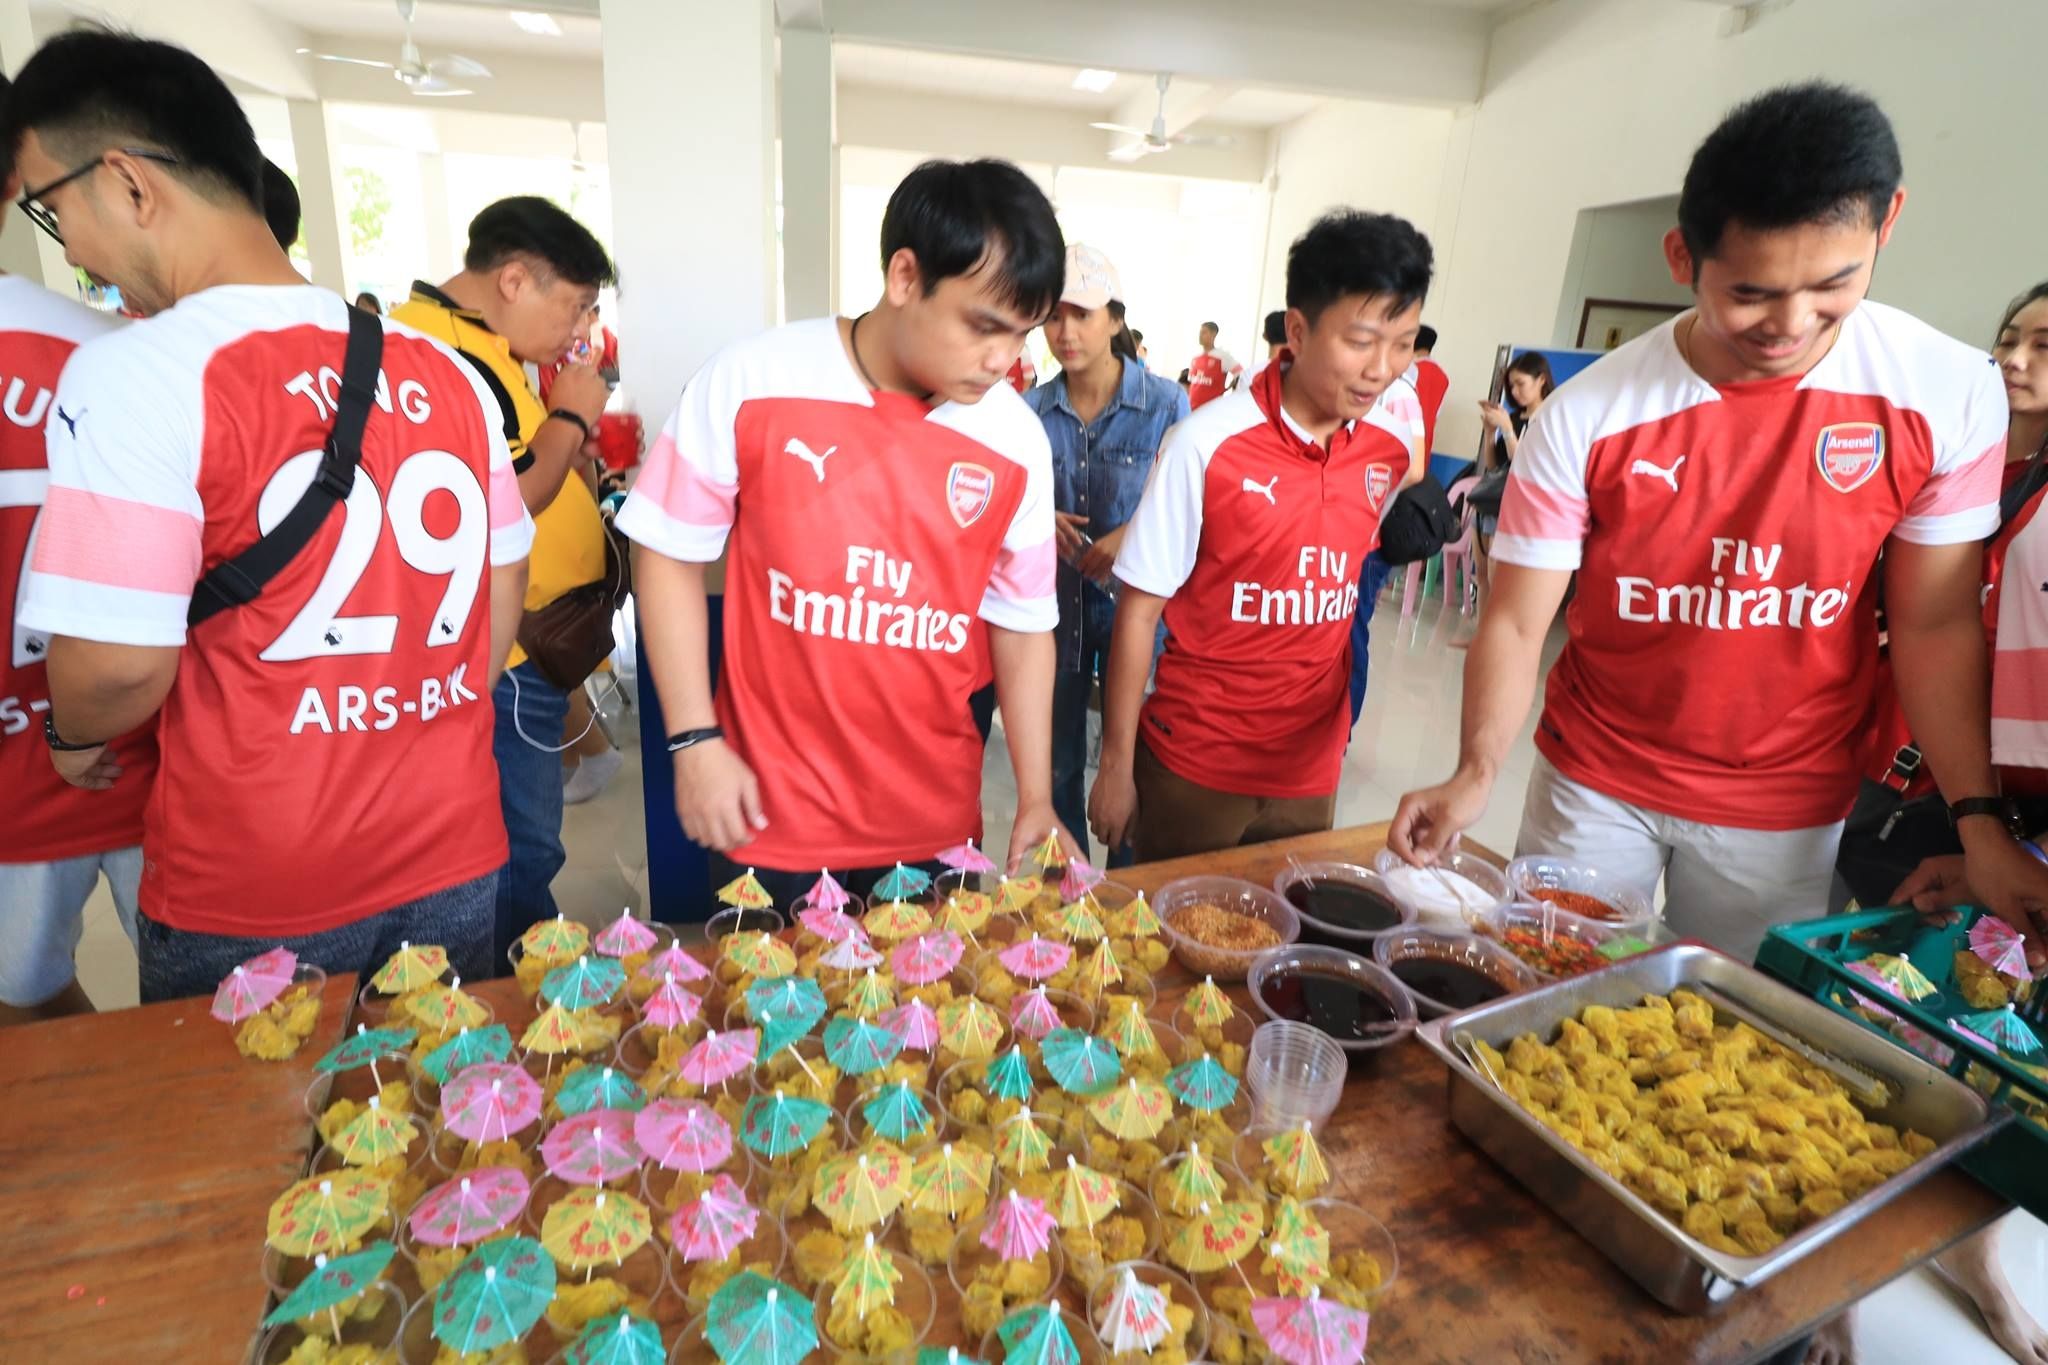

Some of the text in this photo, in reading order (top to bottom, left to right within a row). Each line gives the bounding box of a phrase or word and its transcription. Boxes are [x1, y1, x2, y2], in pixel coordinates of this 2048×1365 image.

[1828, 435, 1873, 449] Arsenal
[257, 449, 488, 662] 29
[845, 544, 912, 598] Fly
[1298, 546, 1347, 584] Fly
[1711, 536, 1782, 582] Fly
[767, 567, 970, 654] Emirates
